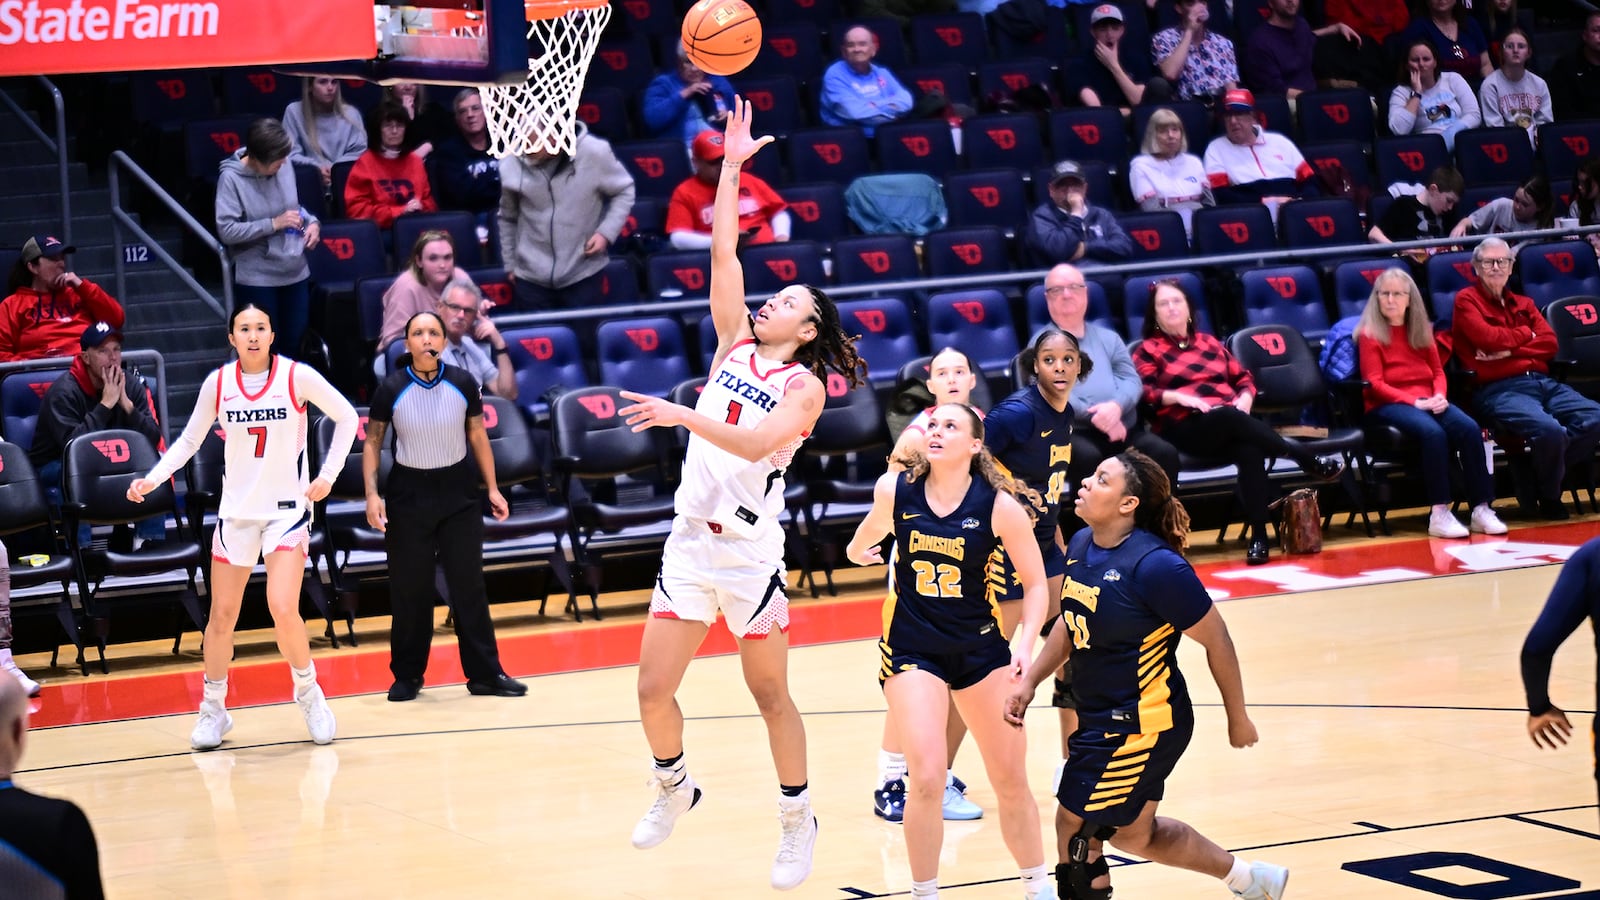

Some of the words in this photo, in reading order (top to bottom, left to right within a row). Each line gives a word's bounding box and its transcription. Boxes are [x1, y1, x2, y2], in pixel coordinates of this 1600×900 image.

[0, 0, 110, 44] State
[113, 0, 219, 39] Farm
[125, 246, 148, 262] 112
[226, 408, 287, 422] FLYERS
[725, 400, 743, 425] 1
[247, 426, 267, 458] 7
[911, 560, 963, 598] 22
